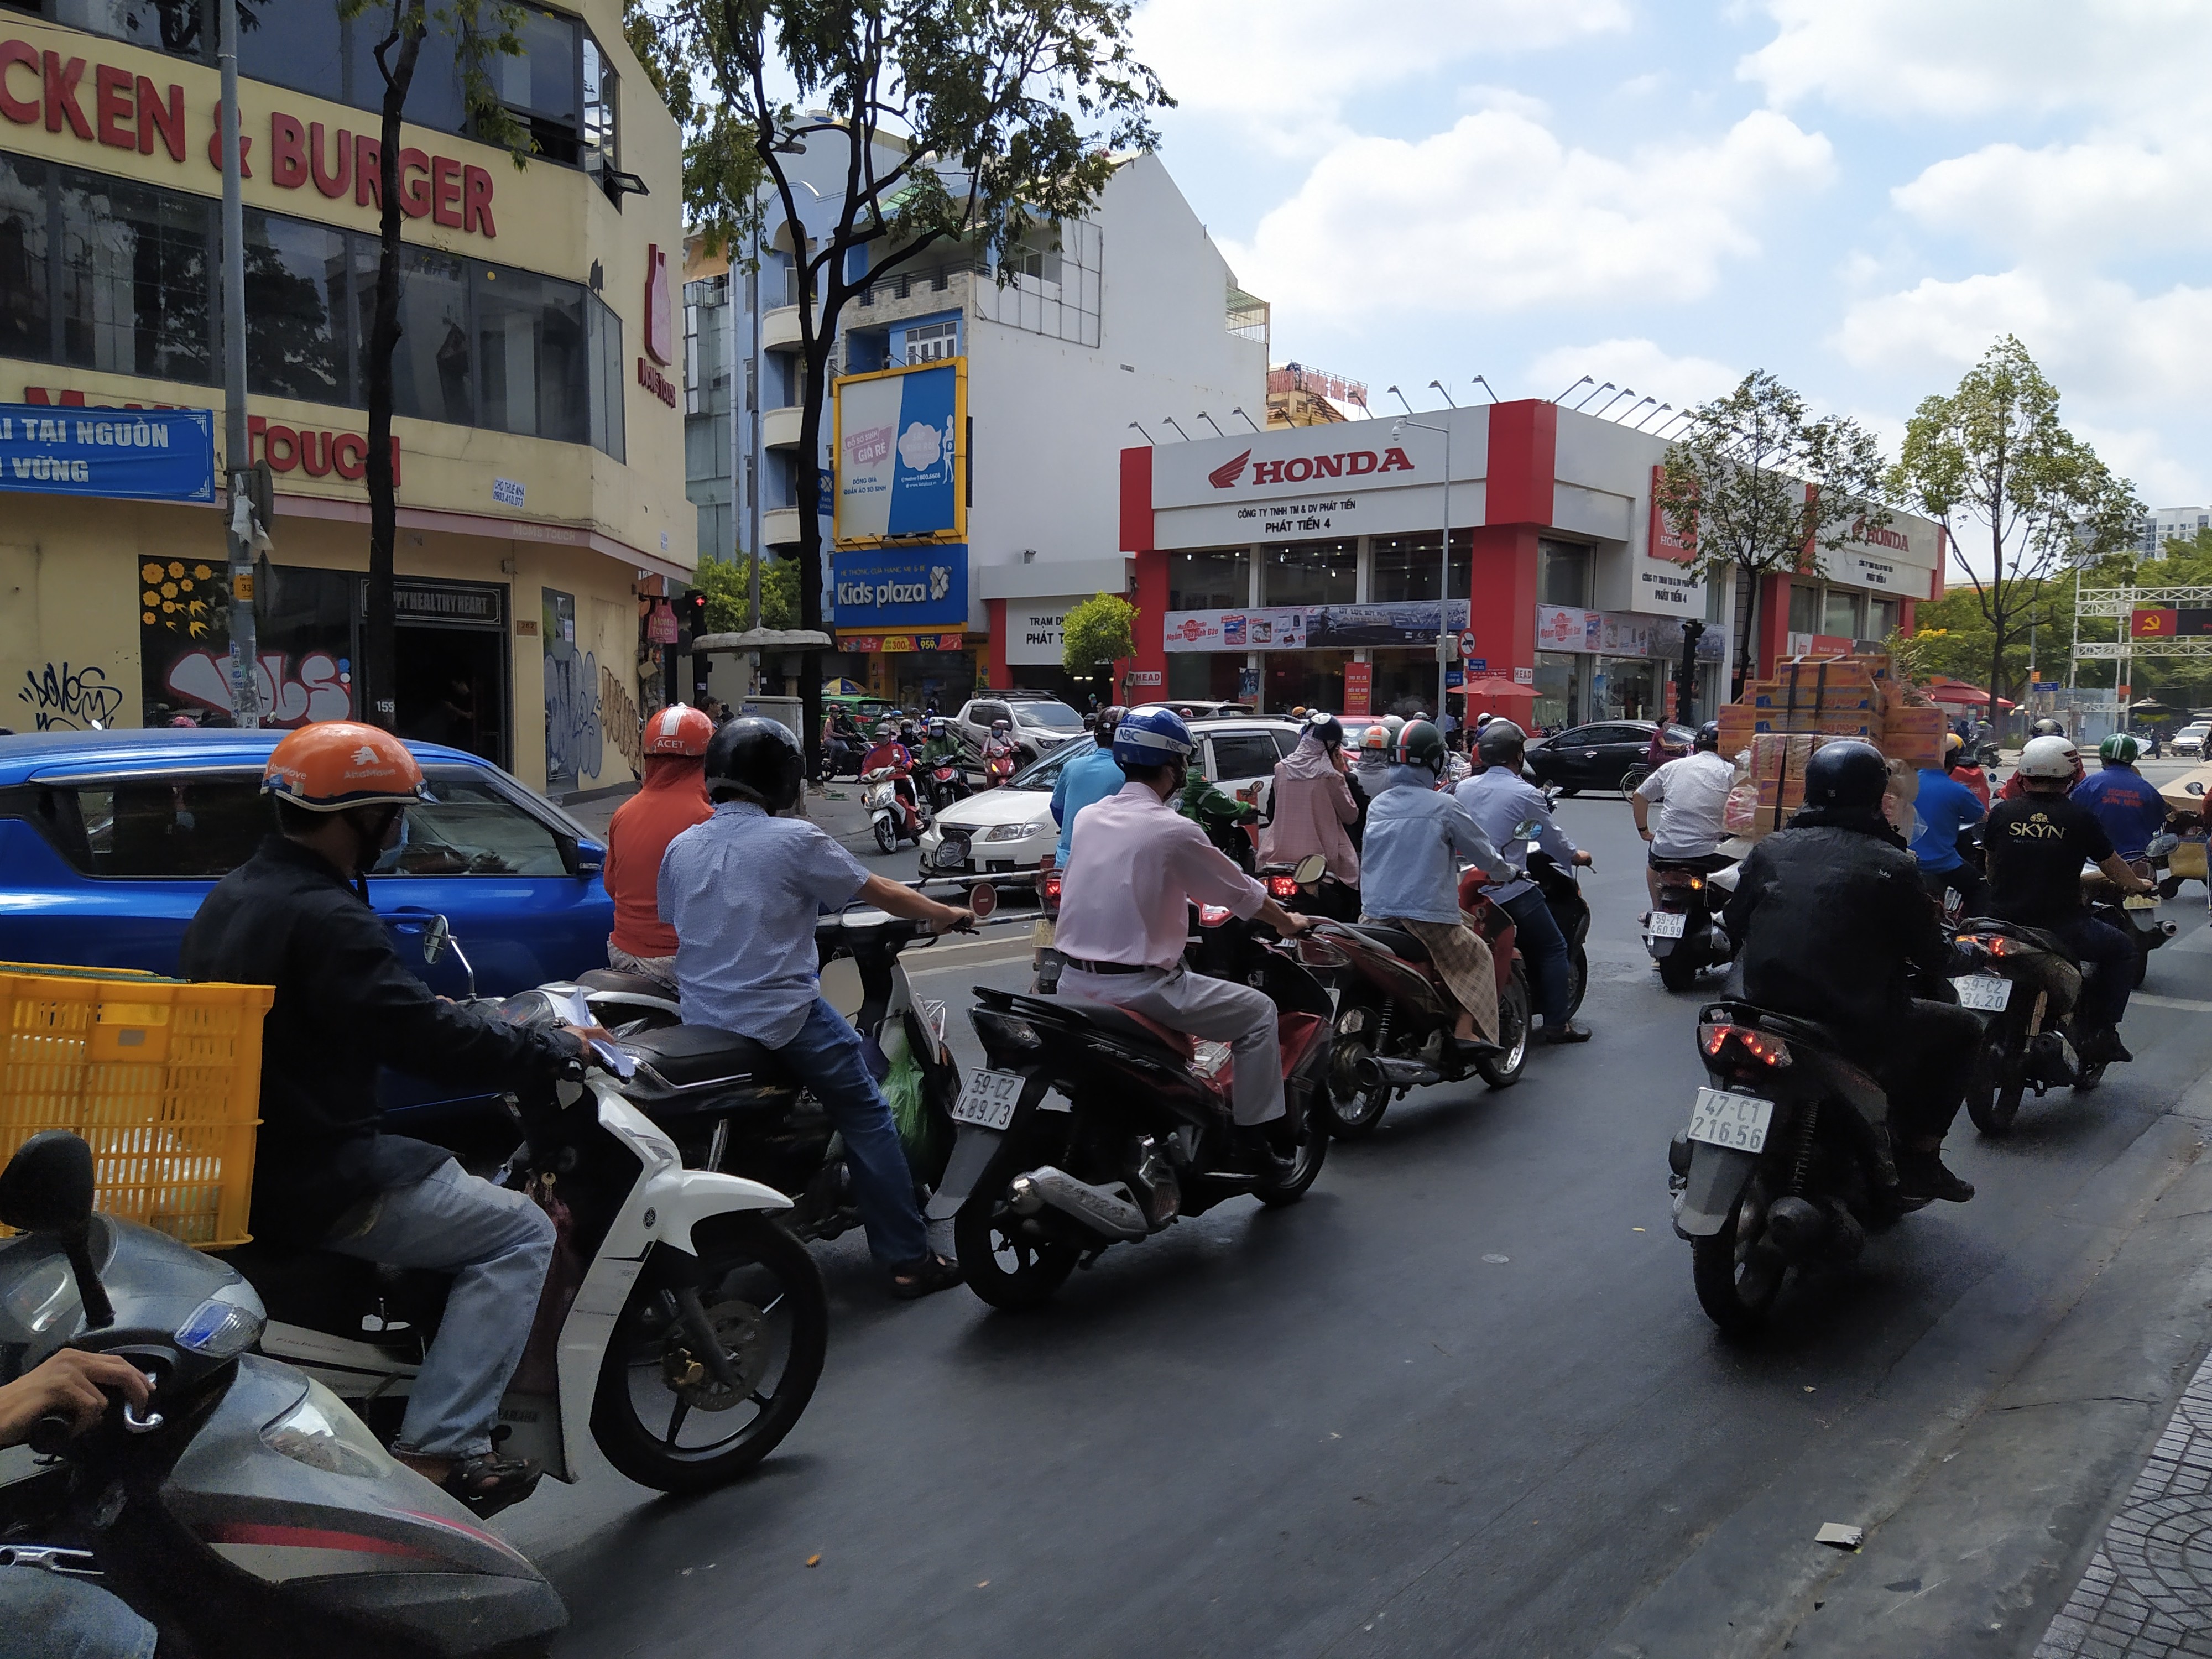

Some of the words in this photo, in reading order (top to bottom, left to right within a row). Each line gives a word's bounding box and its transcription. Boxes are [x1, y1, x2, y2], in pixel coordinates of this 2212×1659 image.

[272, 112, 497, 238] BURGER
[21, 419, 66, 446] TẠI
[864, 431, 879, 442] SINH
[247, 415, 400, 487] TOUC
[12, 455, 89, 483] VỮNG
[1253, 447, 1415, 485] HONDA
[1238, 508, 1256, 519] CÔNG
[1258, 508, 1267, 517] TY
[1270, 507, 1287, 516] TNHH
[1290, 505, 1299, 514] TM
[1301, 505, 1306, 513] &
[1308, 504, 1318, 513] DV
[1319, 500, 1337, 512] PHÁT
[1340, 498, 1356, 510] TIẾN
[1265, 519, 1293, 533] PHÁT
[1297, 515, 1320, 531] TIẾN
[1323, 518, 1331, 529] 4
[1866, 528, 1910, 552] HONDA
[837, 581, 874, 605] Kids
[876, 580, 927, 608] plaza
[1029, 617, 1053, 629] TRẠM
[1026, 630, 1055, 645] PHÁT
[1515, 669, 1532, 679] HEAD
[377, 700, 395, 713] 155
[657, 739, 685, 748] ACET
[2008, 821, 2067, 839] SKYN
[1651, 924, 1681, 936] 460.99
[1656, 914, 1680, 925] 59-Z1
[1962, 978, 2003, 994] 59-C2
[970, 1073, 1015, 1100] 59-C2
[958, 1095, 1011, 1125] 489.73
[1705, 1094, 1761, 1124] 47-C1
[1690, 1116, 1763, 1149] 216.56
